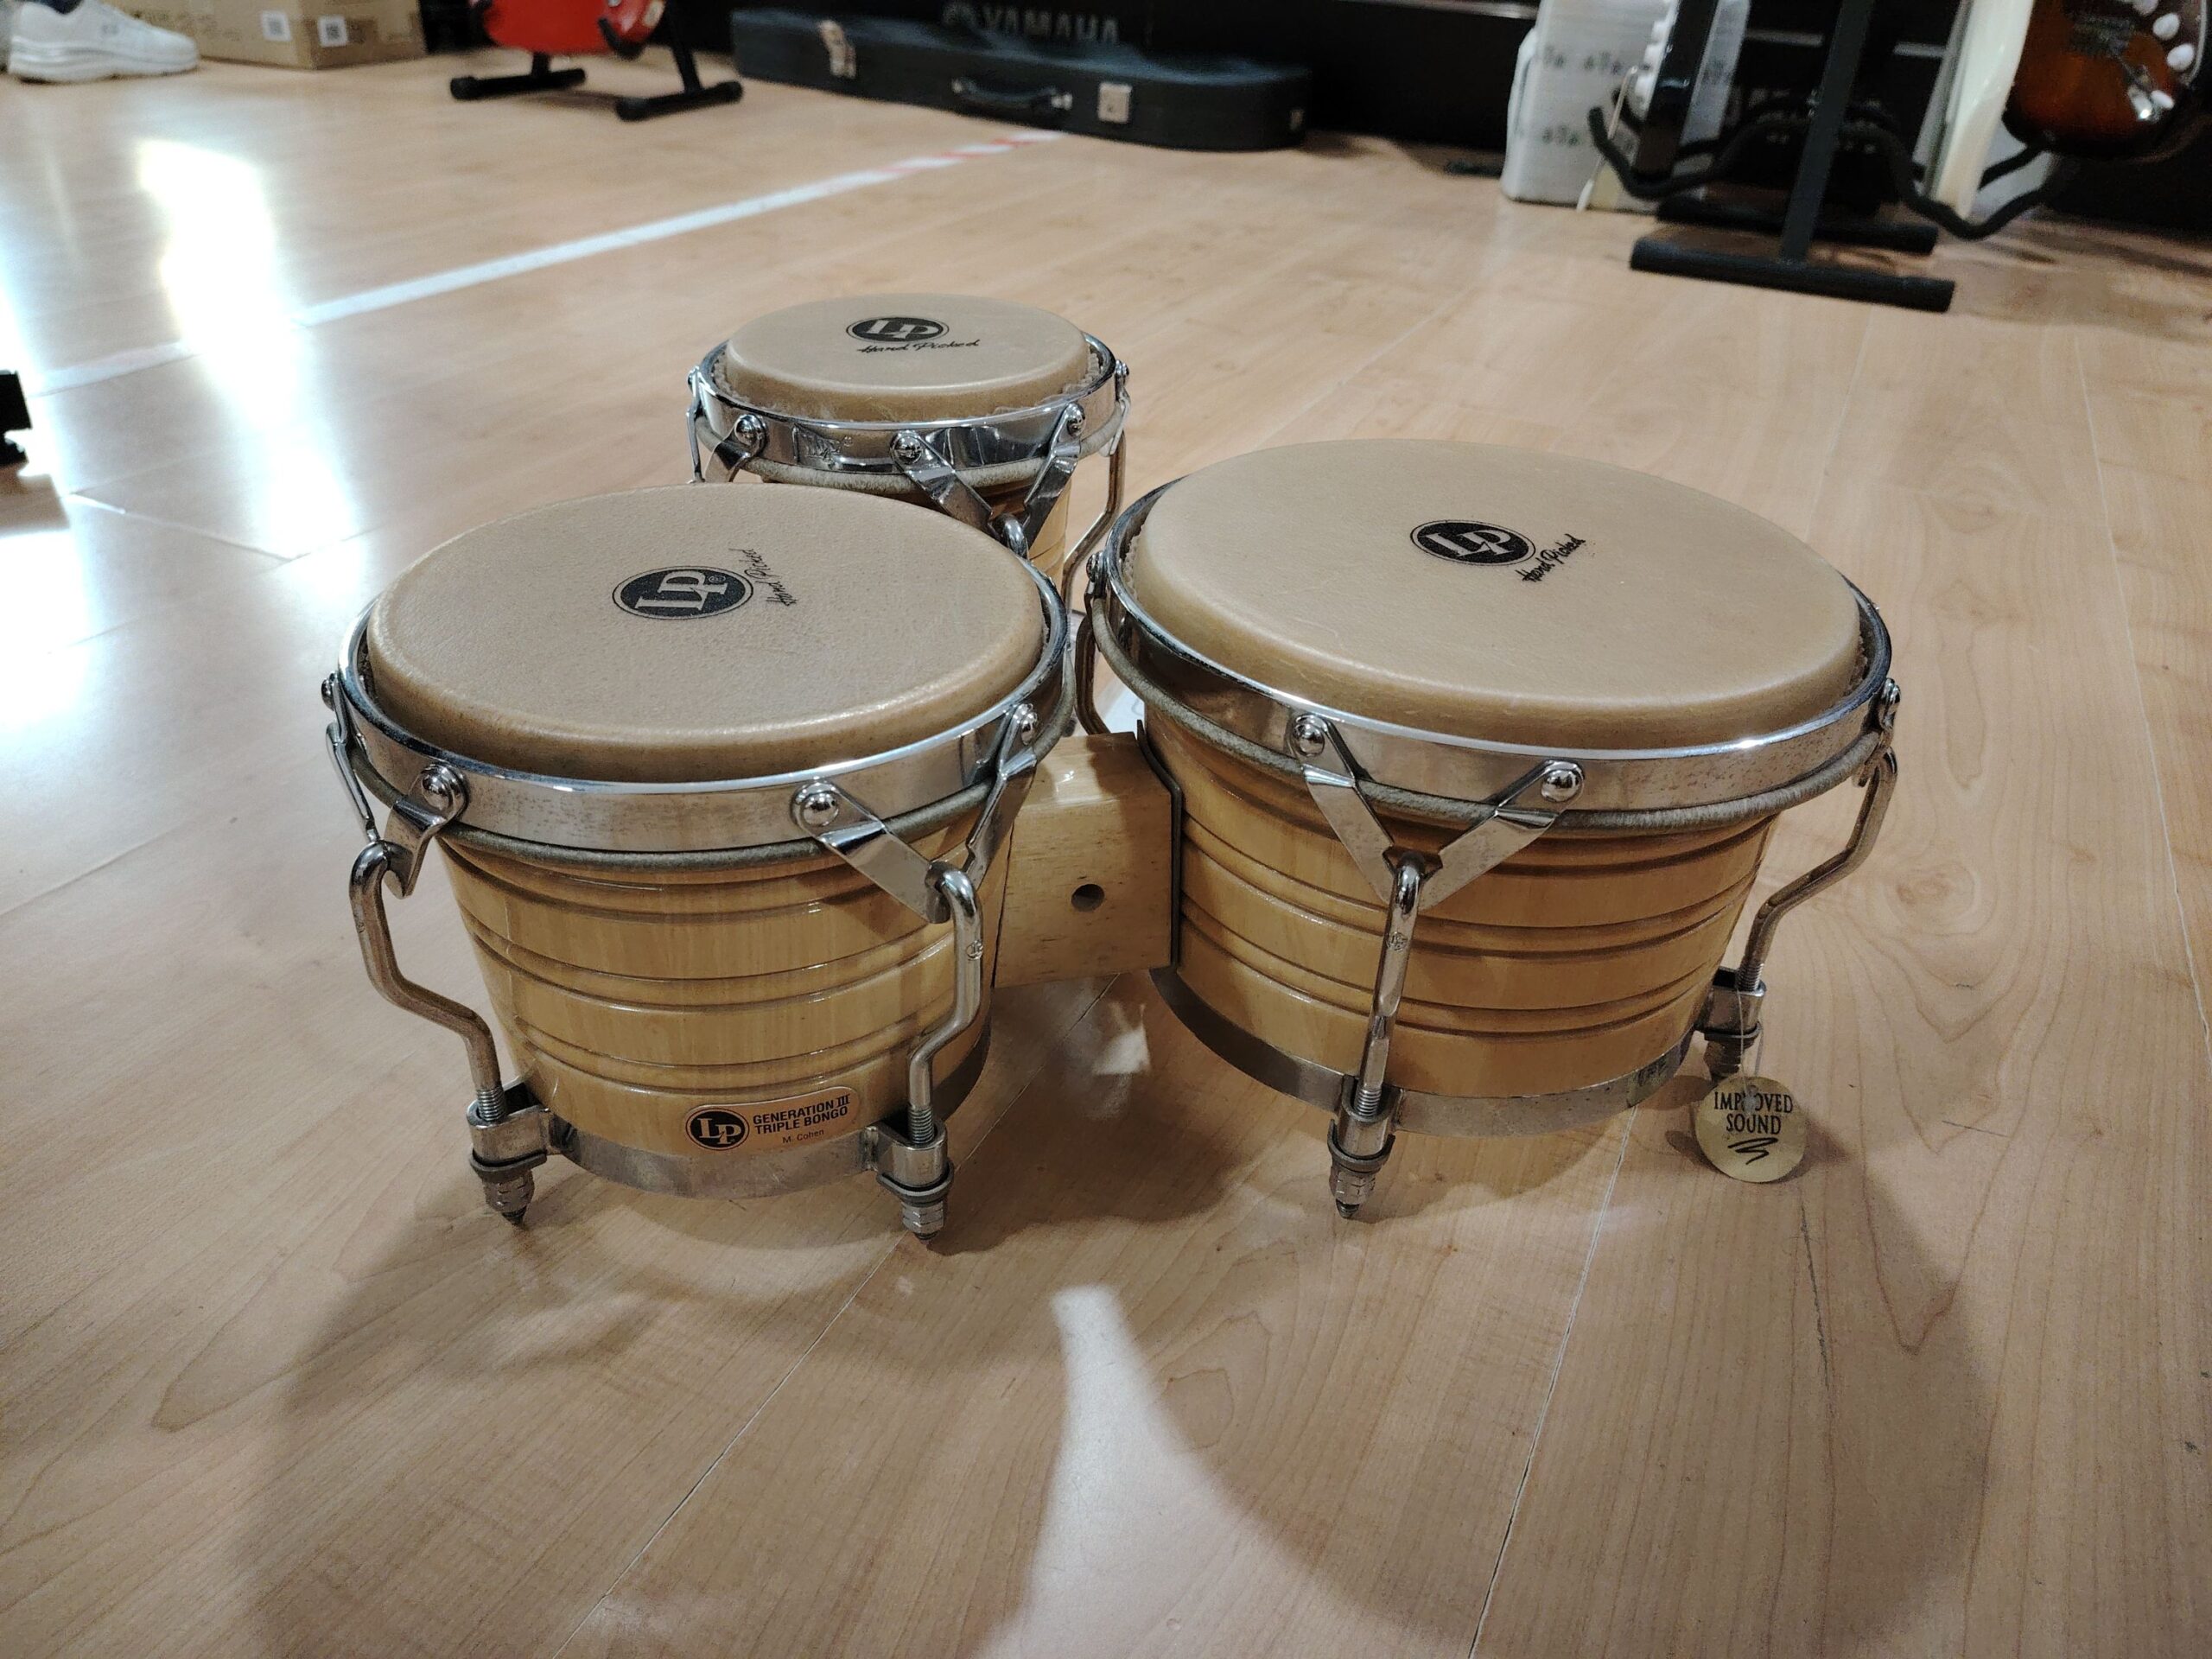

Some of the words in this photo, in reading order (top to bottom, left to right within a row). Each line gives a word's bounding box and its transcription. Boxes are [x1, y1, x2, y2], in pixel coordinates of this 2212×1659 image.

[982, 3, 1121, 41] YAMAHA
[1515, 557, 1555, 582] Hand
[1541, 533, 1586, 564] Picked
[753, 1101, 835, 1125] GENERATION
[836, 1094, 851, 1108] III
[754, 1119, 800, 1135] TRIPLE
[804, 1106, 849, 1127] BONGO
[1726, 1113, 1782, 1135] SOUND
[697, 1118, 742, 1145] LP
[797, 1128, 824, 1141] Cohen
